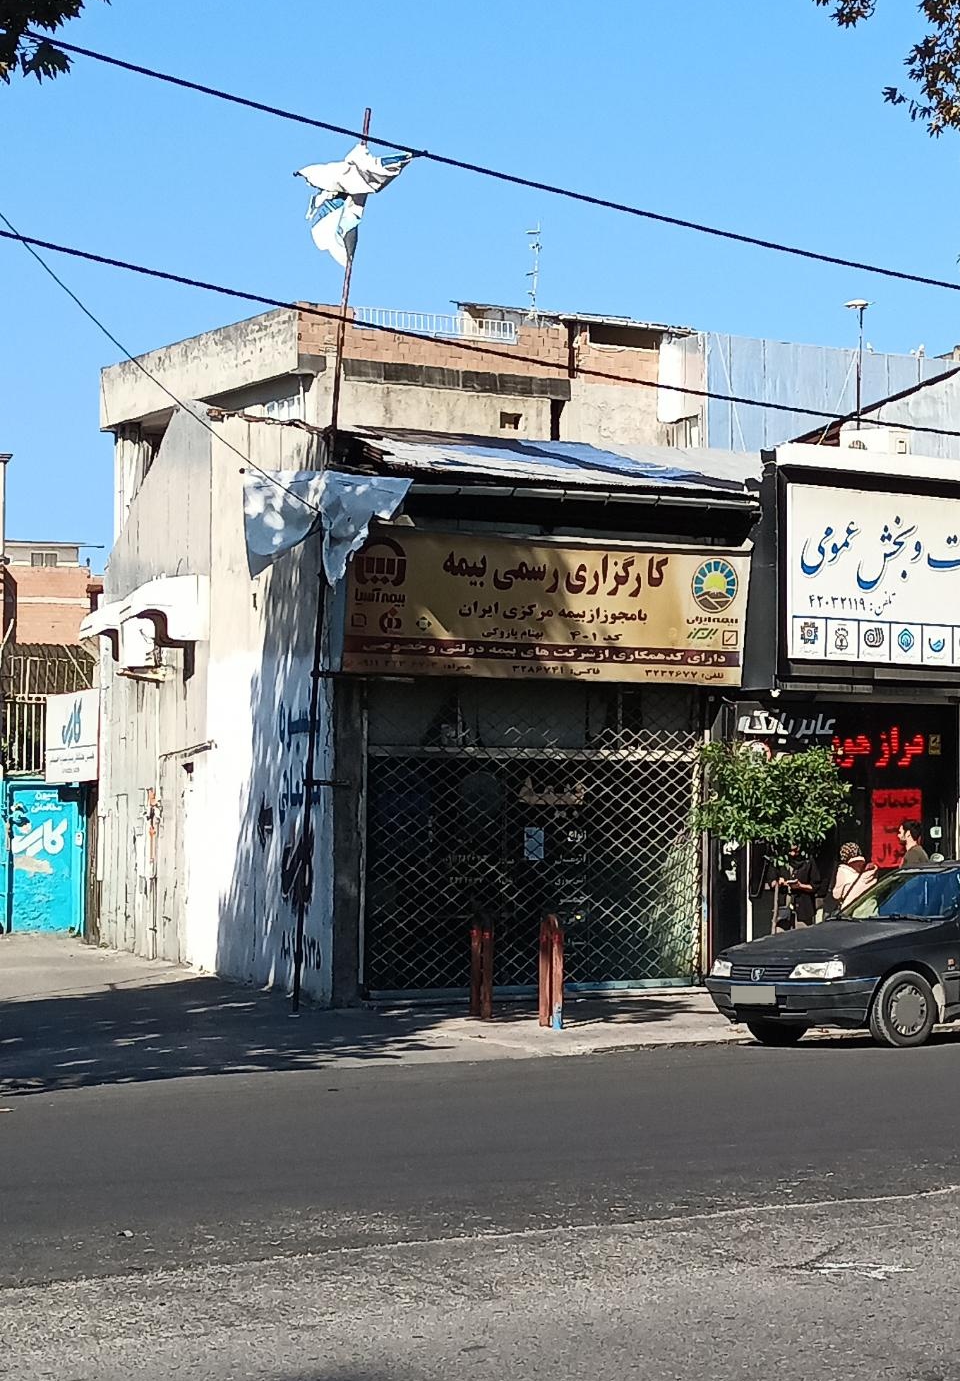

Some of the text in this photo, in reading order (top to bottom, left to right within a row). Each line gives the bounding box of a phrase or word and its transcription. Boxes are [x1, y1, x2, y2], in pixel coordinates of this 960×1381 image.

[801, 521, 859, 575] عمومی
[857, 515, 916, 590] بخش
[911, 540, 921, 561] و
[442, 551, 669, 597] کارگزاری رسمی بیمه
[459, 601, 499, 618] ایران
[503, 603, 553, 621] مرکزی
[602, 633, 623, 642] کد
[440, 643, 485, 656] دولتی
[488, 646, 517, 657] بیمه
[687, 652, 726, 664] دارای
